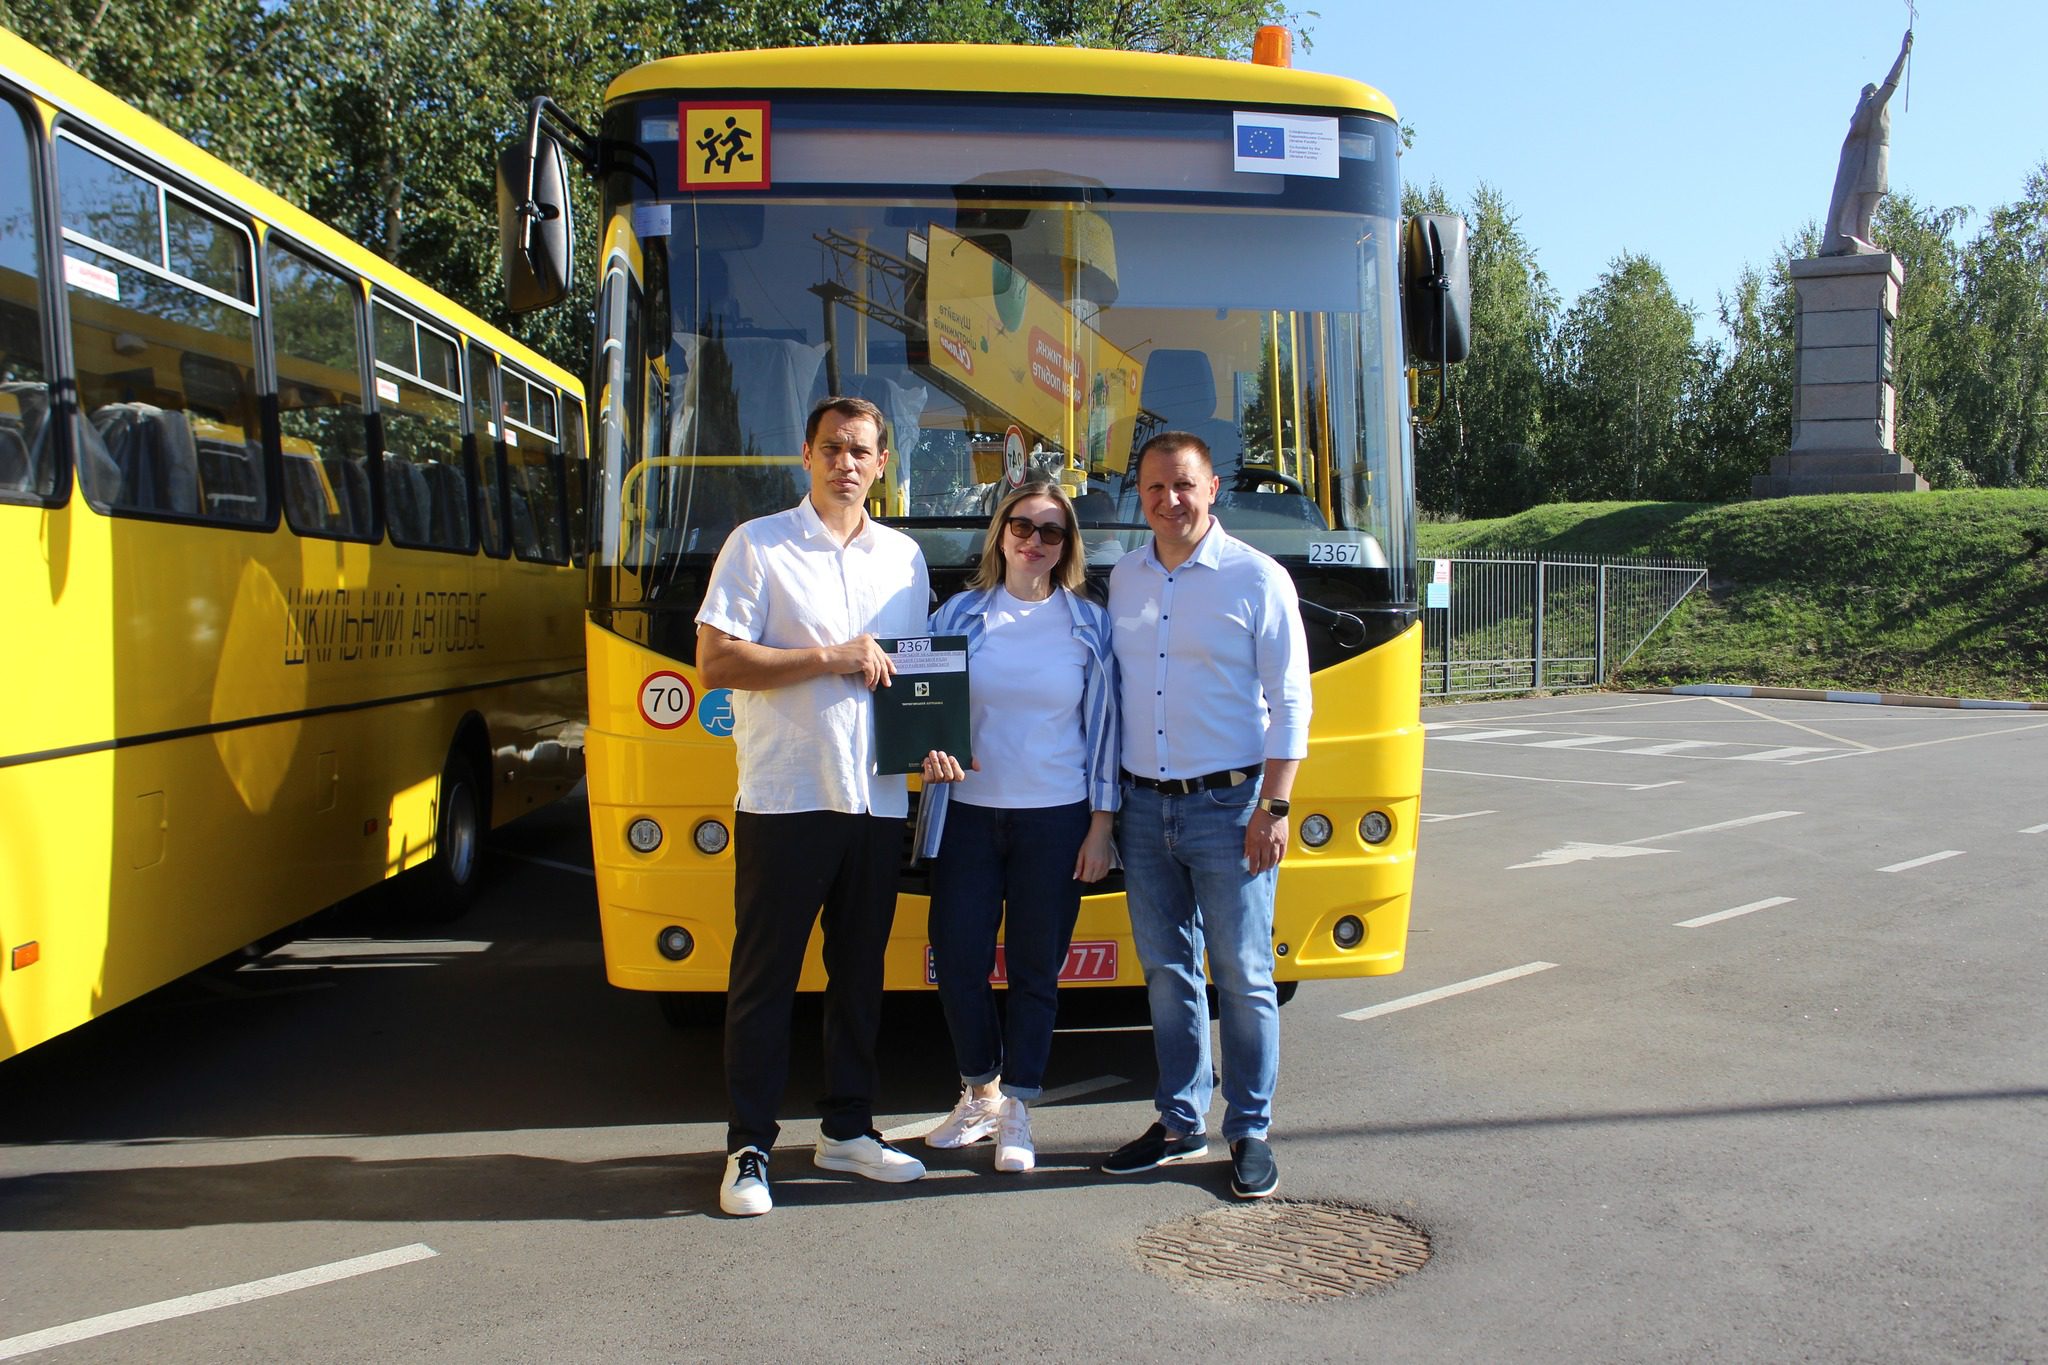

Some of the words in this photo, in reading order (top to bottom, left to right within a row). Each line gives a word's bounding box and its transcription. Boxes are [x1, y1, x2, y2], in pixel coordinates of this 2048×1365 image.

[1311, 544, 1359, 562] 2367
[410, 591, 487, 655] АВТОБУС
[899, 640, 930, 653] 2367
[650, 687, 683, 712] 70
